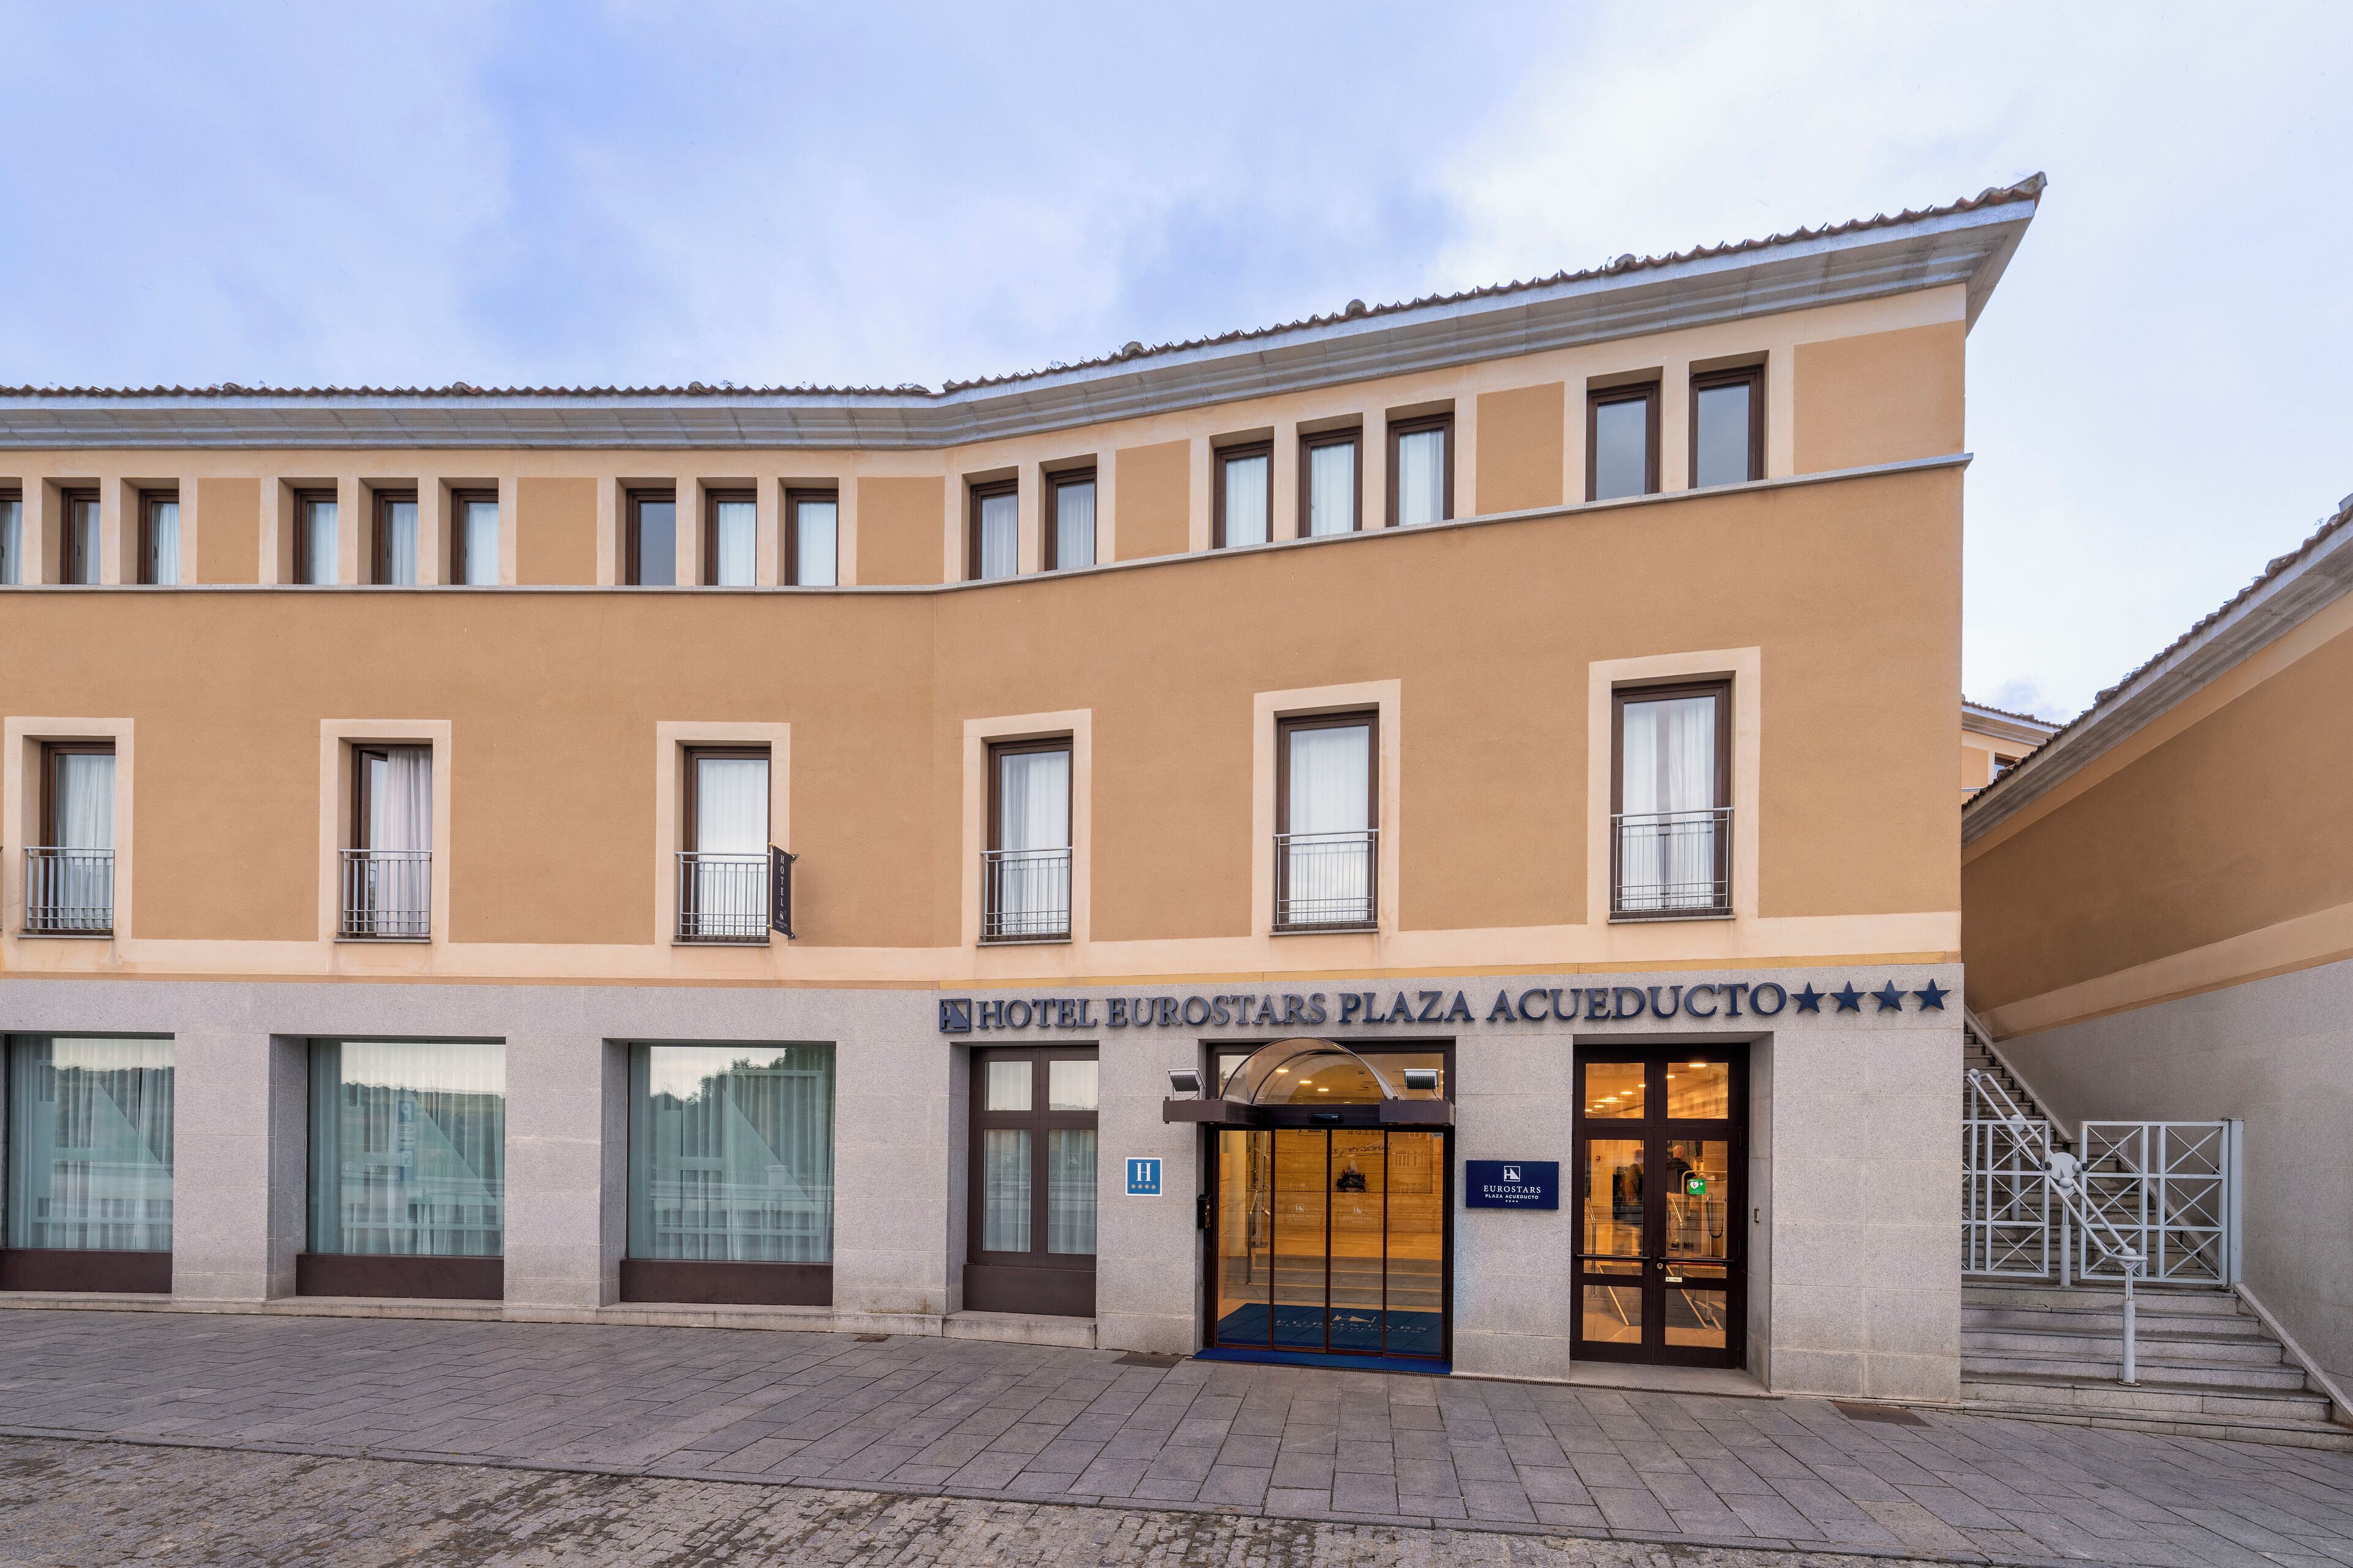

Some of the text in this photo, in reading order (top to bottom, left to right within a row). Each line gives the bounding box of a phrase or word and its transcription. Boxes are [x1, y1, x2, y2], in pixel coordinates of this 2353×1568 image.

[976, 982, 1787, 1028] HOTEL EUROSTARS PLAZA ACUEDUCTO
[1135, 1162, 1152, 1181] H
[1483, 1185, 1541, 1194] EUROSTARS
